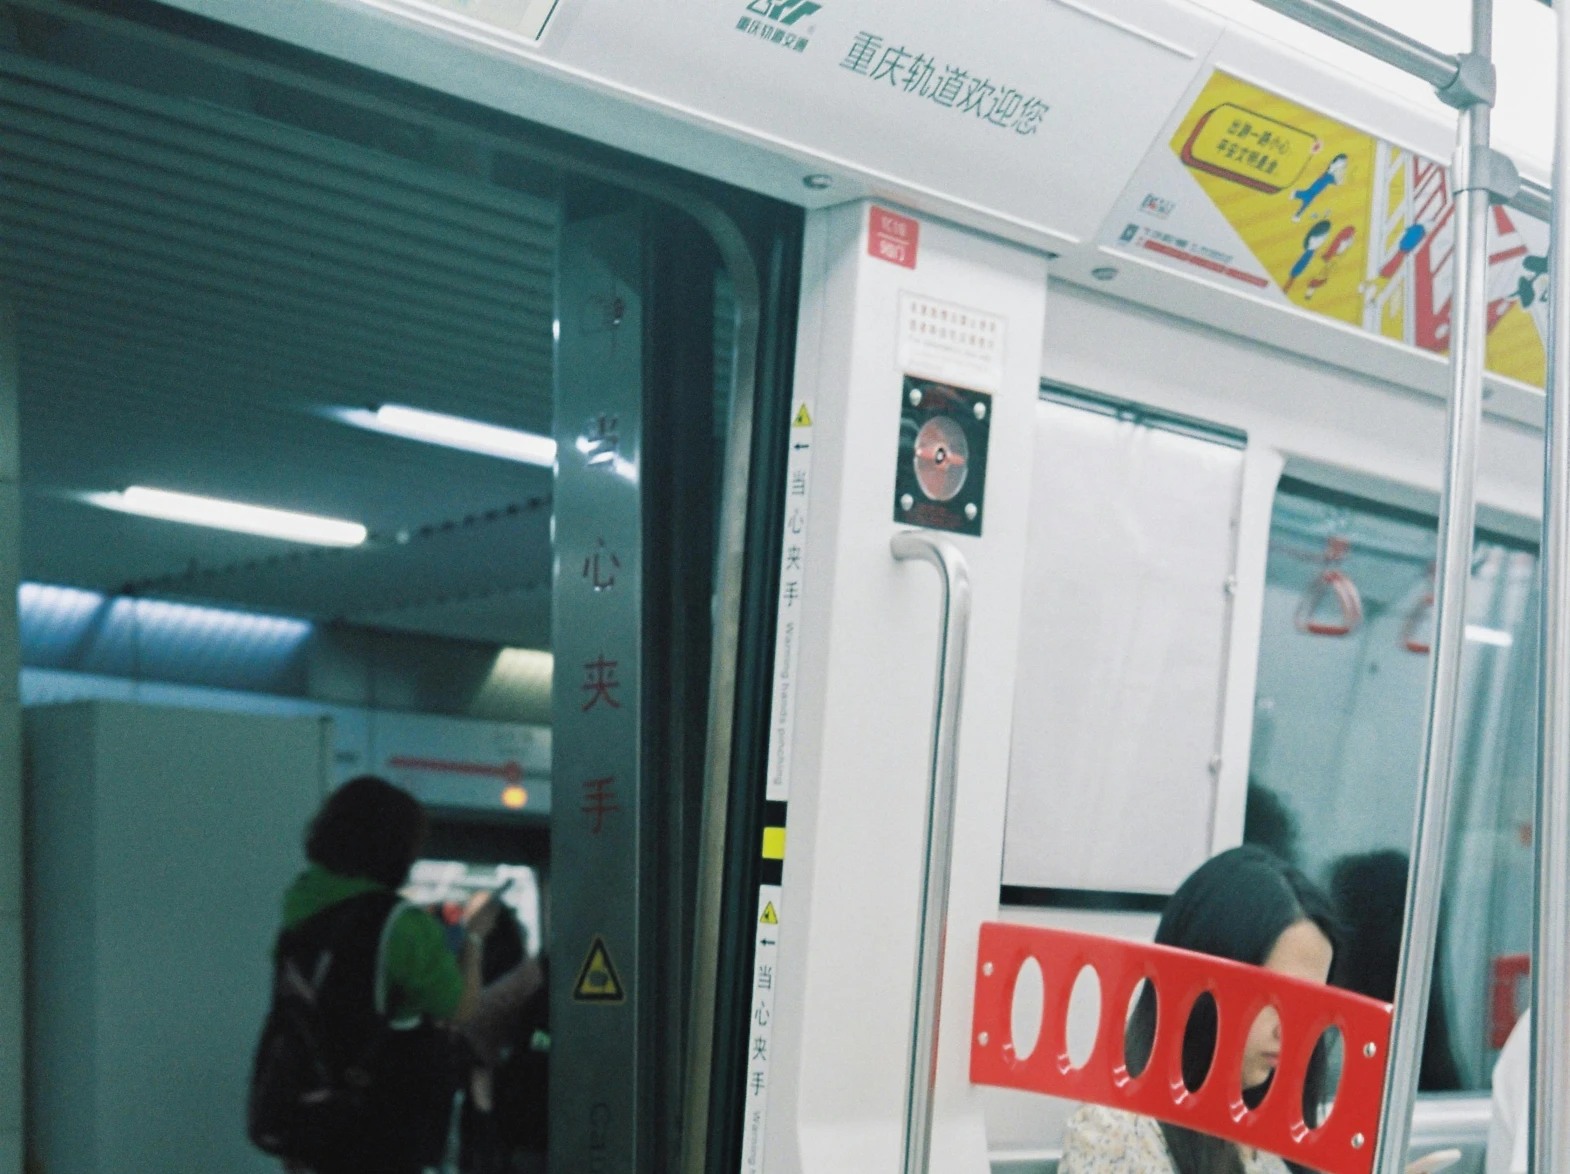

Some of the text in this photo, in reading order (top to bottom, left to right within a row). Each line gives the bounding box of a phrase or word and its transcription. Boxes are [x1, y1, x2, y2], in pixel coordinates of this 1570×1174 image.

[839, 31, 1051, 135] 重庆轨道欢迎您
[783, 471, 806, 608] 当心夹手
[750, 965, 772, 1096] 当心夹手
